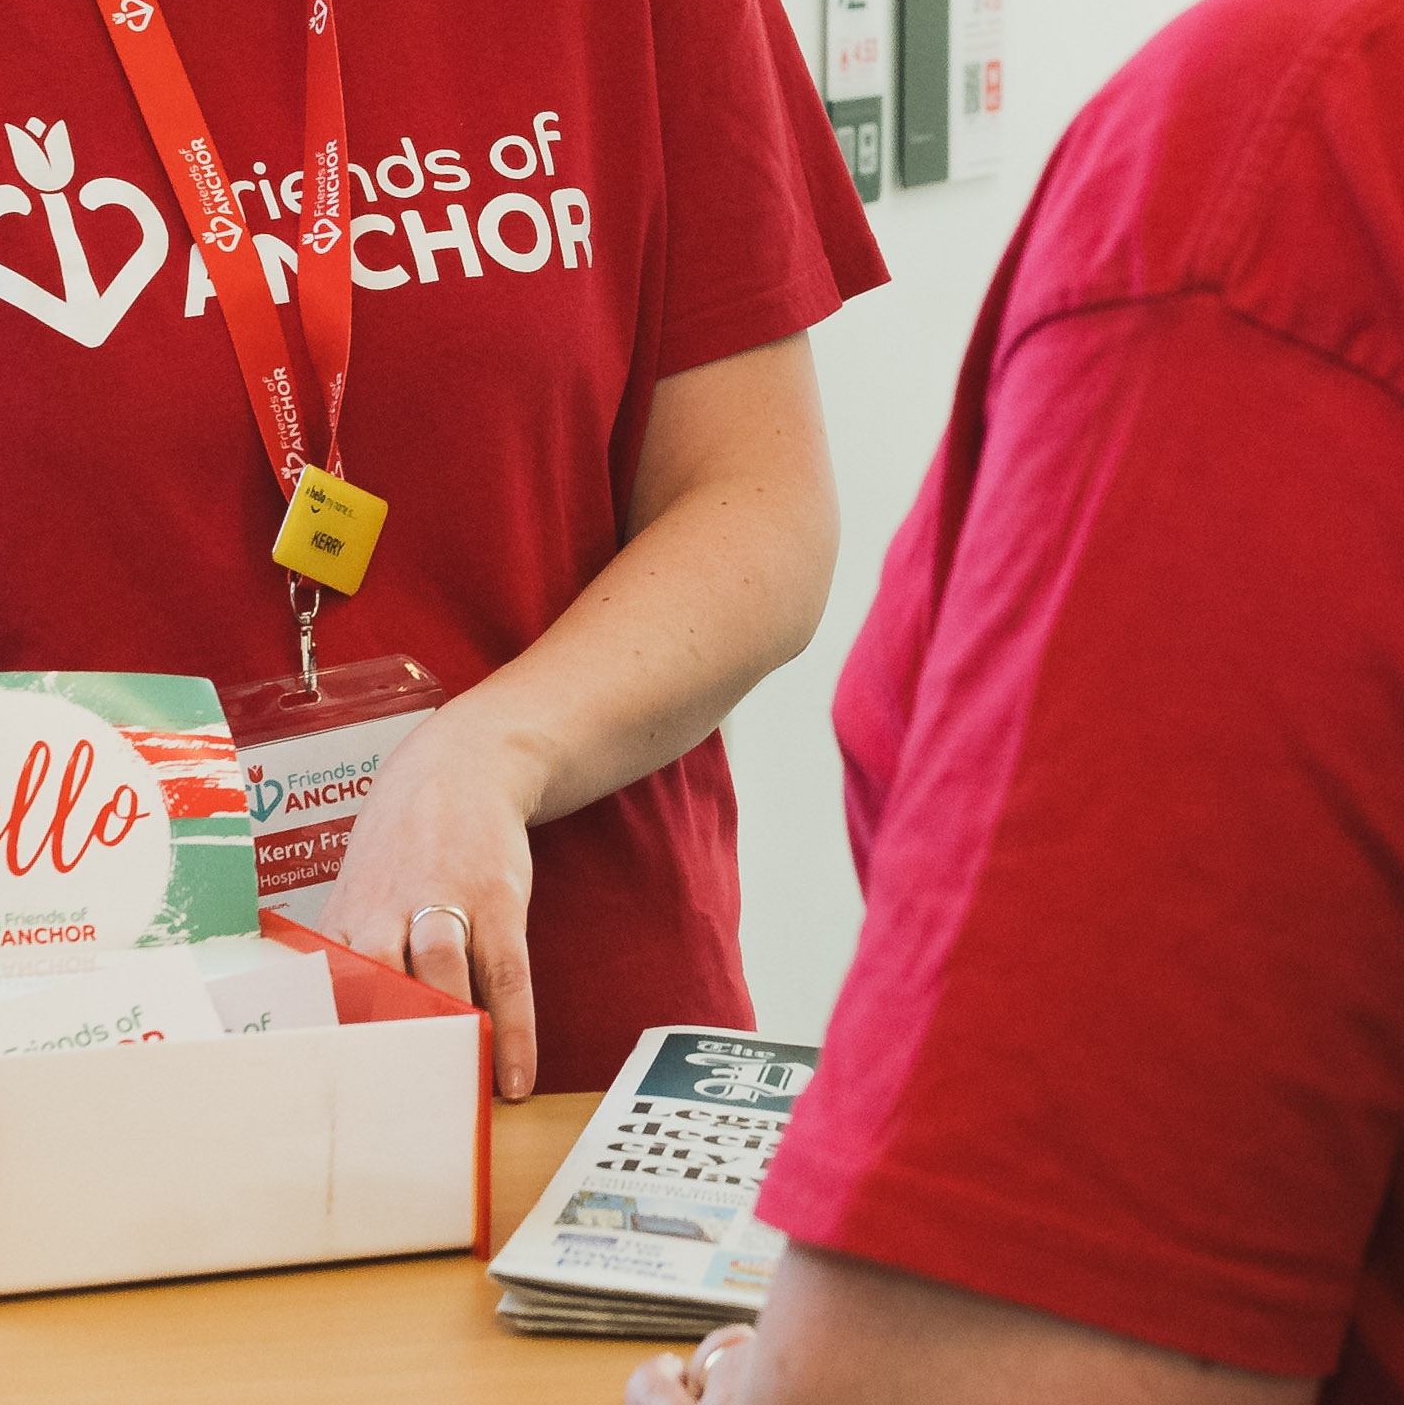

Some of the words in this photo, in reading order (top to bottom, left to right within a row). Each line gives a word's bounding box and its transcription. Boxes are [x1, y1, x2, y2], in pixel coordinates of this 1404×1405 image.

[178, 149, 194, 162] of
[230, 137, 471, 223] riends
[489, 111, 562, 180] of
[315, 152, 326, 164] of
[189, 165, 216, 215] Friends
[191, 137, 233, 215] ANCHOR
[314, 168, 326, 217] Friends
[326, 140, 340, 217] ANCHOR
[262, 377, 276, 392] of
[270, 395, 290, 450] Friends
[274, 367, 305, 451] ANCHOR
[311, 530, 345, 557] KERRY
[287, 762, 356, 790] Friends
[361, 754, 380, 773] of
[284, 776, 374, 814] ANCHO
[258, 838, 322, 864] Kerry
[320, 830, 352, 851] Fra
[259, 863, 319, 888] Hospital
[321, 857, 344, 874] Vol
[4, 910, 67, 927] Friends
[70, 908, 88, 923] of
[0, 924, 96, 947] ANCHOR
[116, 1005, 144, 1034] of
[631, 1102, 788, 1132] Lega
